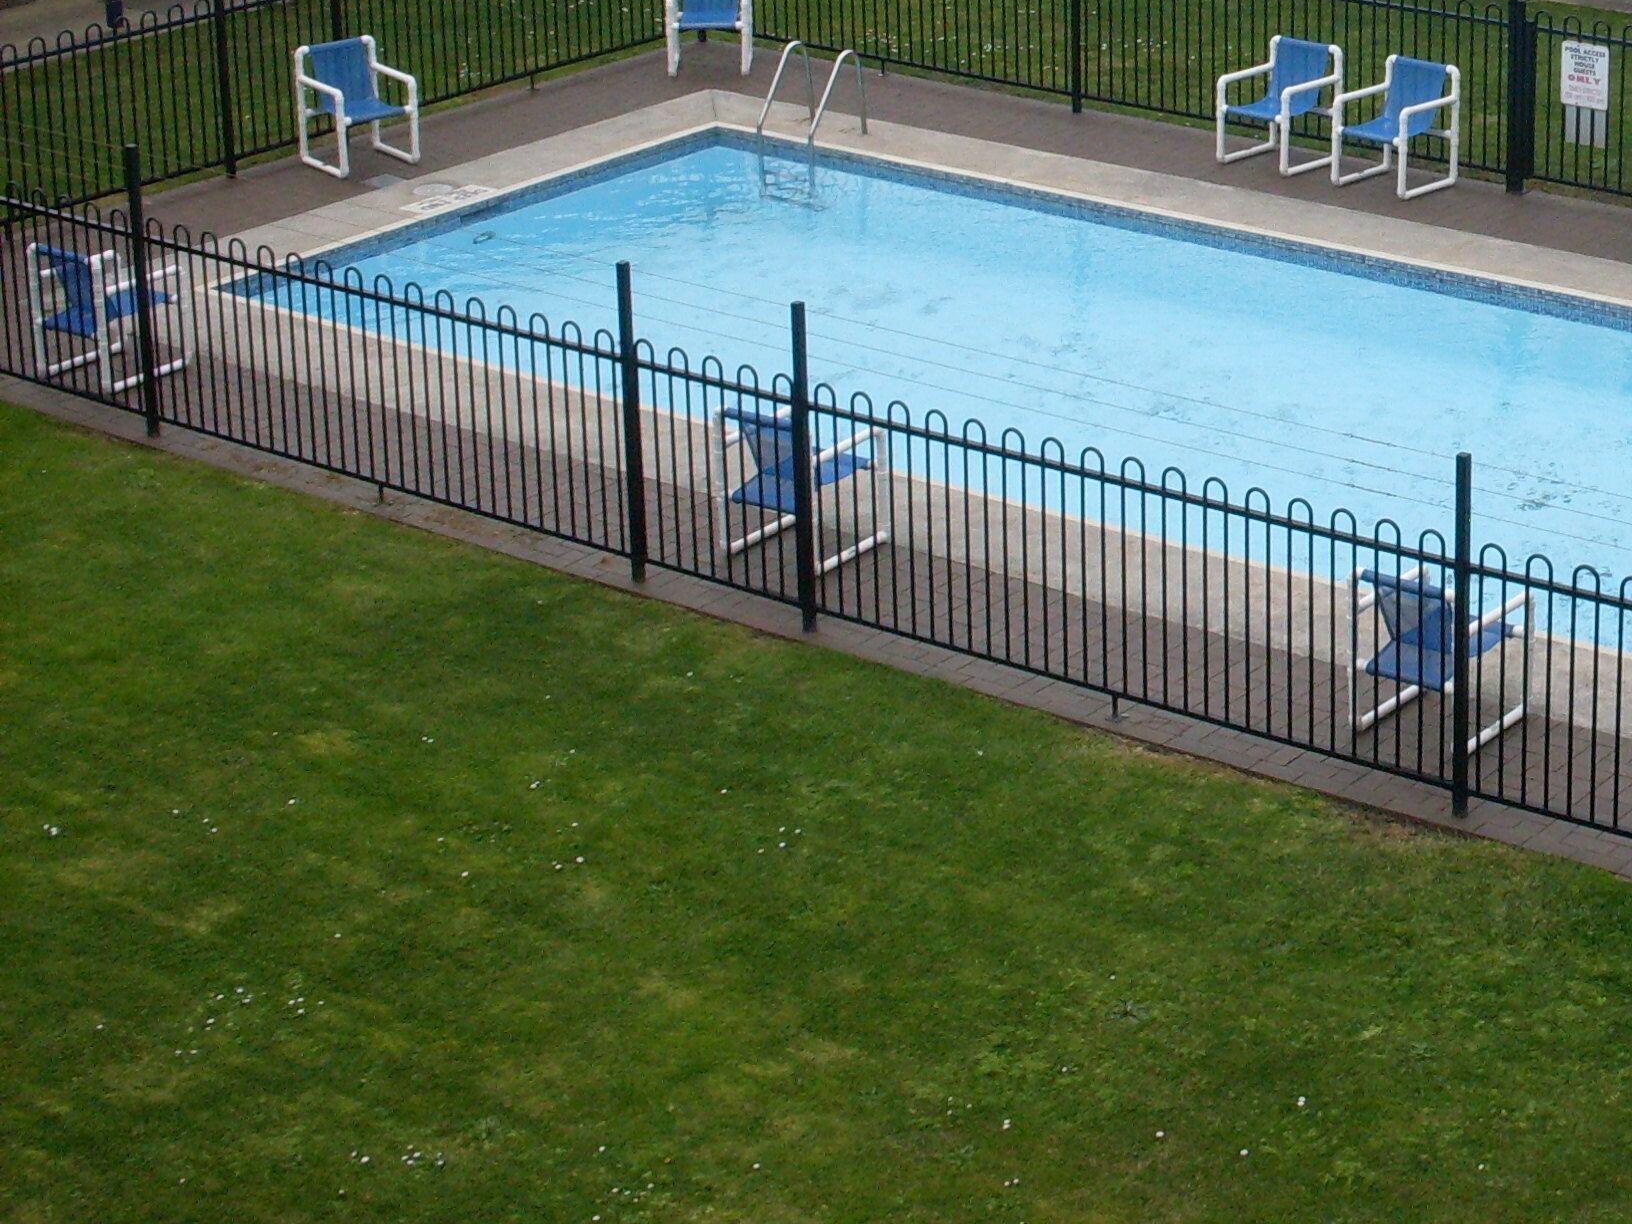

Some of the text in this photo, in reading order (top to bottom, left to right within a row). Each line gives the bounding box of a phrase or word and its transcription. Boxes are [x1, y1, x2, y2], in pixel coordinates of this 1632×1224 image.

[1571, 54, 1599, 63] STRICTLY
[1574, 68, 1596, 76] GUESTS
[1568, 74, 1600, 85] ONLY
